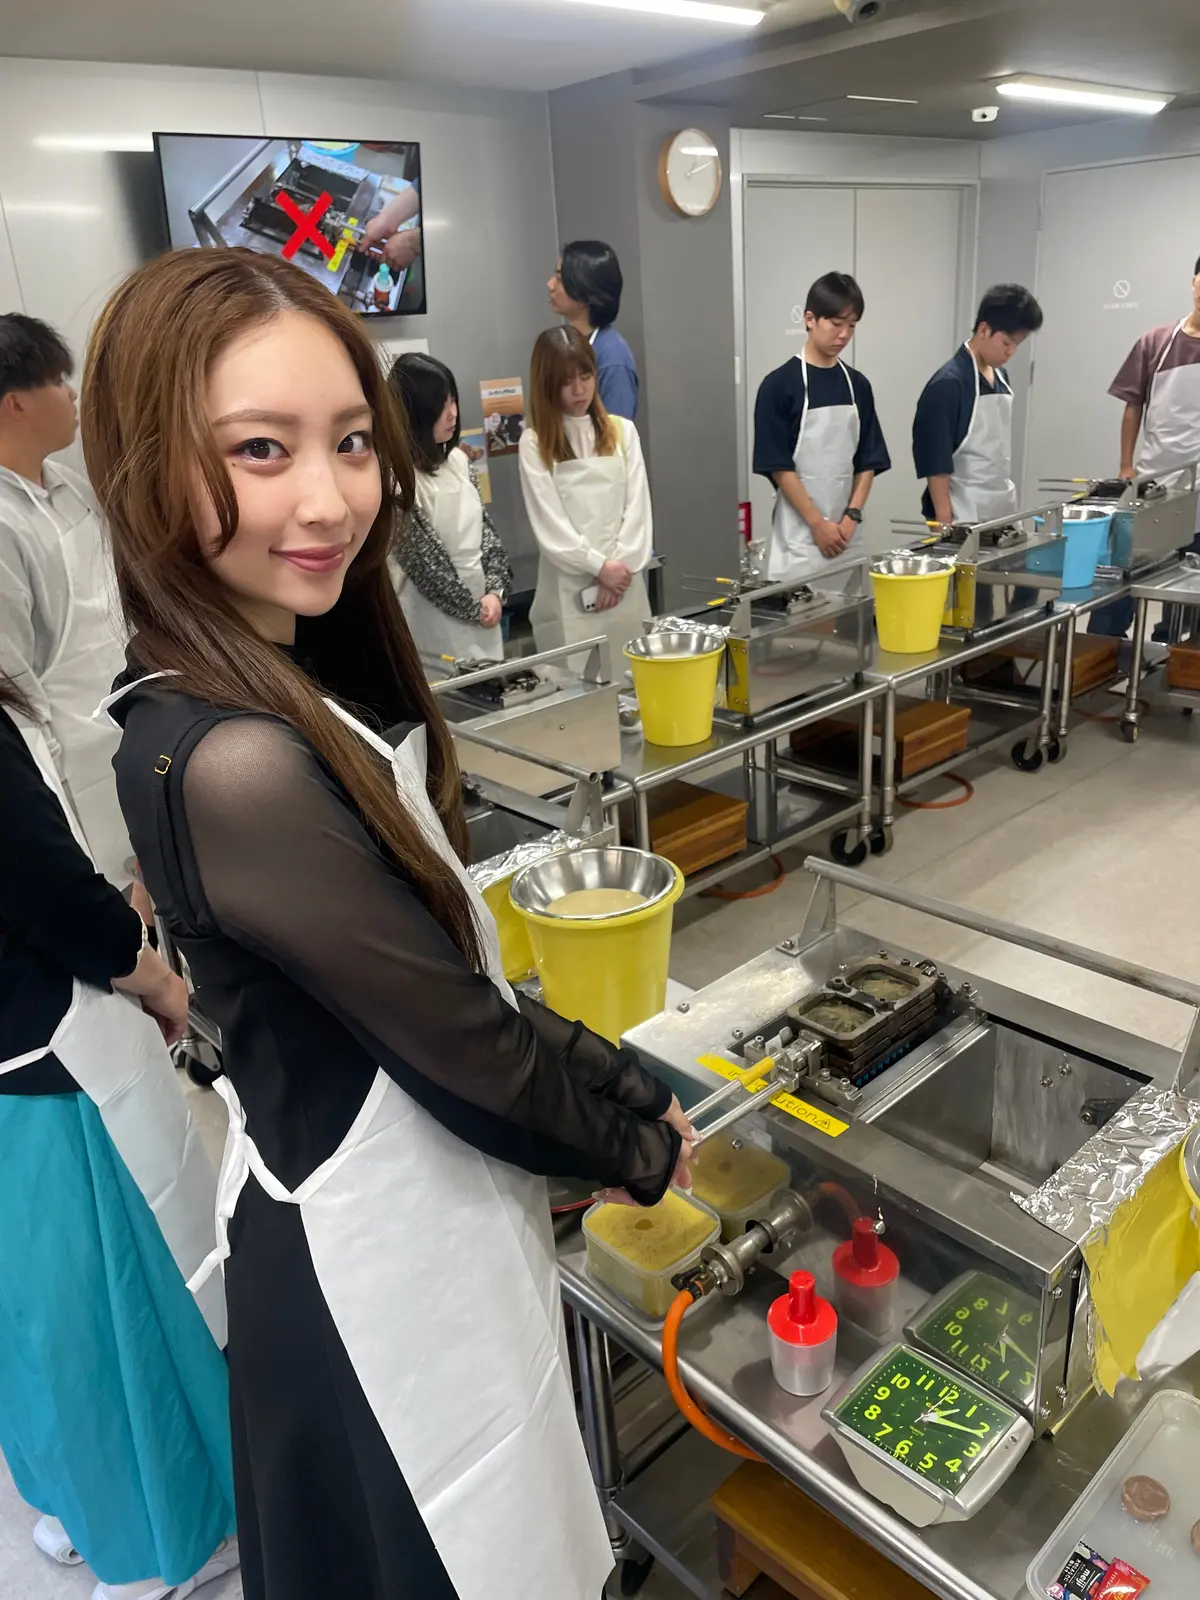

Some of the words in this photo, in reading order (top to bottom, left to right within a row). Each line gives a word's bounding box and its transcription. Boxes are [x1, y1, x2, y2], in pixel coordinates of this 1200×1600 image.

[755, 1082, 817, 1124] Cution
[890, 1373, 911, 1390] 10
[915, 1374, 935, 1391] 11
[873, 1386, 891, 1401] 9
[938, 1386, 960, 1405] 12
[863, 1404, 882, 1421] 8
[965, 1404, 978, 1418] 1
[874, 1422, 894, 1439] 7
[972, 1421, 991, 1439] 2
[895, 1439, 914, 1456] 6
[963, 1441, 981, 1459] 3
[919, 1452, 939, 1470] 5
[944, 1458, 963, 1474] 4
[1075, 1568, 1091, 1589] meiji
